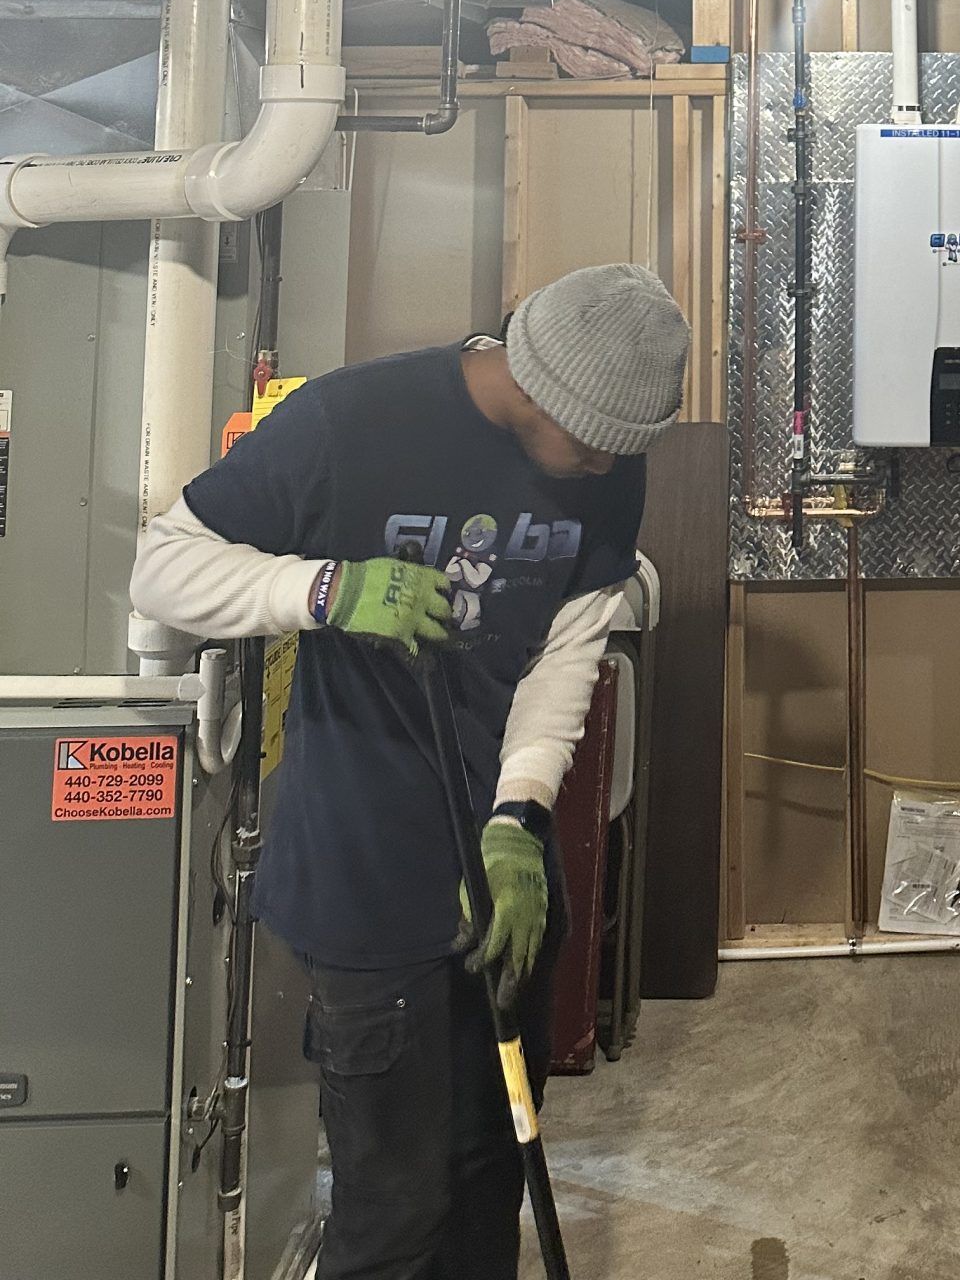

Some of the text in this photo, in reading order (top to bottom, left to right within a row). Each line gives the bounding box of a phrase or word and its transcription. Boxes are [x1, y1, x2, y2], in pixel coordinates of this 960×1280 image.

[891, 129, 939, 138] INSTALLED
[322, 571, 333, 583] NO
[317, 583, 329, 607] WAY
[90, 742, 174, 762] Kobella
[90, 761, 174, 772] Plumbing Heating Cooling
[65, 774, 164, 788] 440-729-2099
[64, 789, 163, 803] 440-352-7790
[55, 806, 172, 818] ChooseKobella.com
